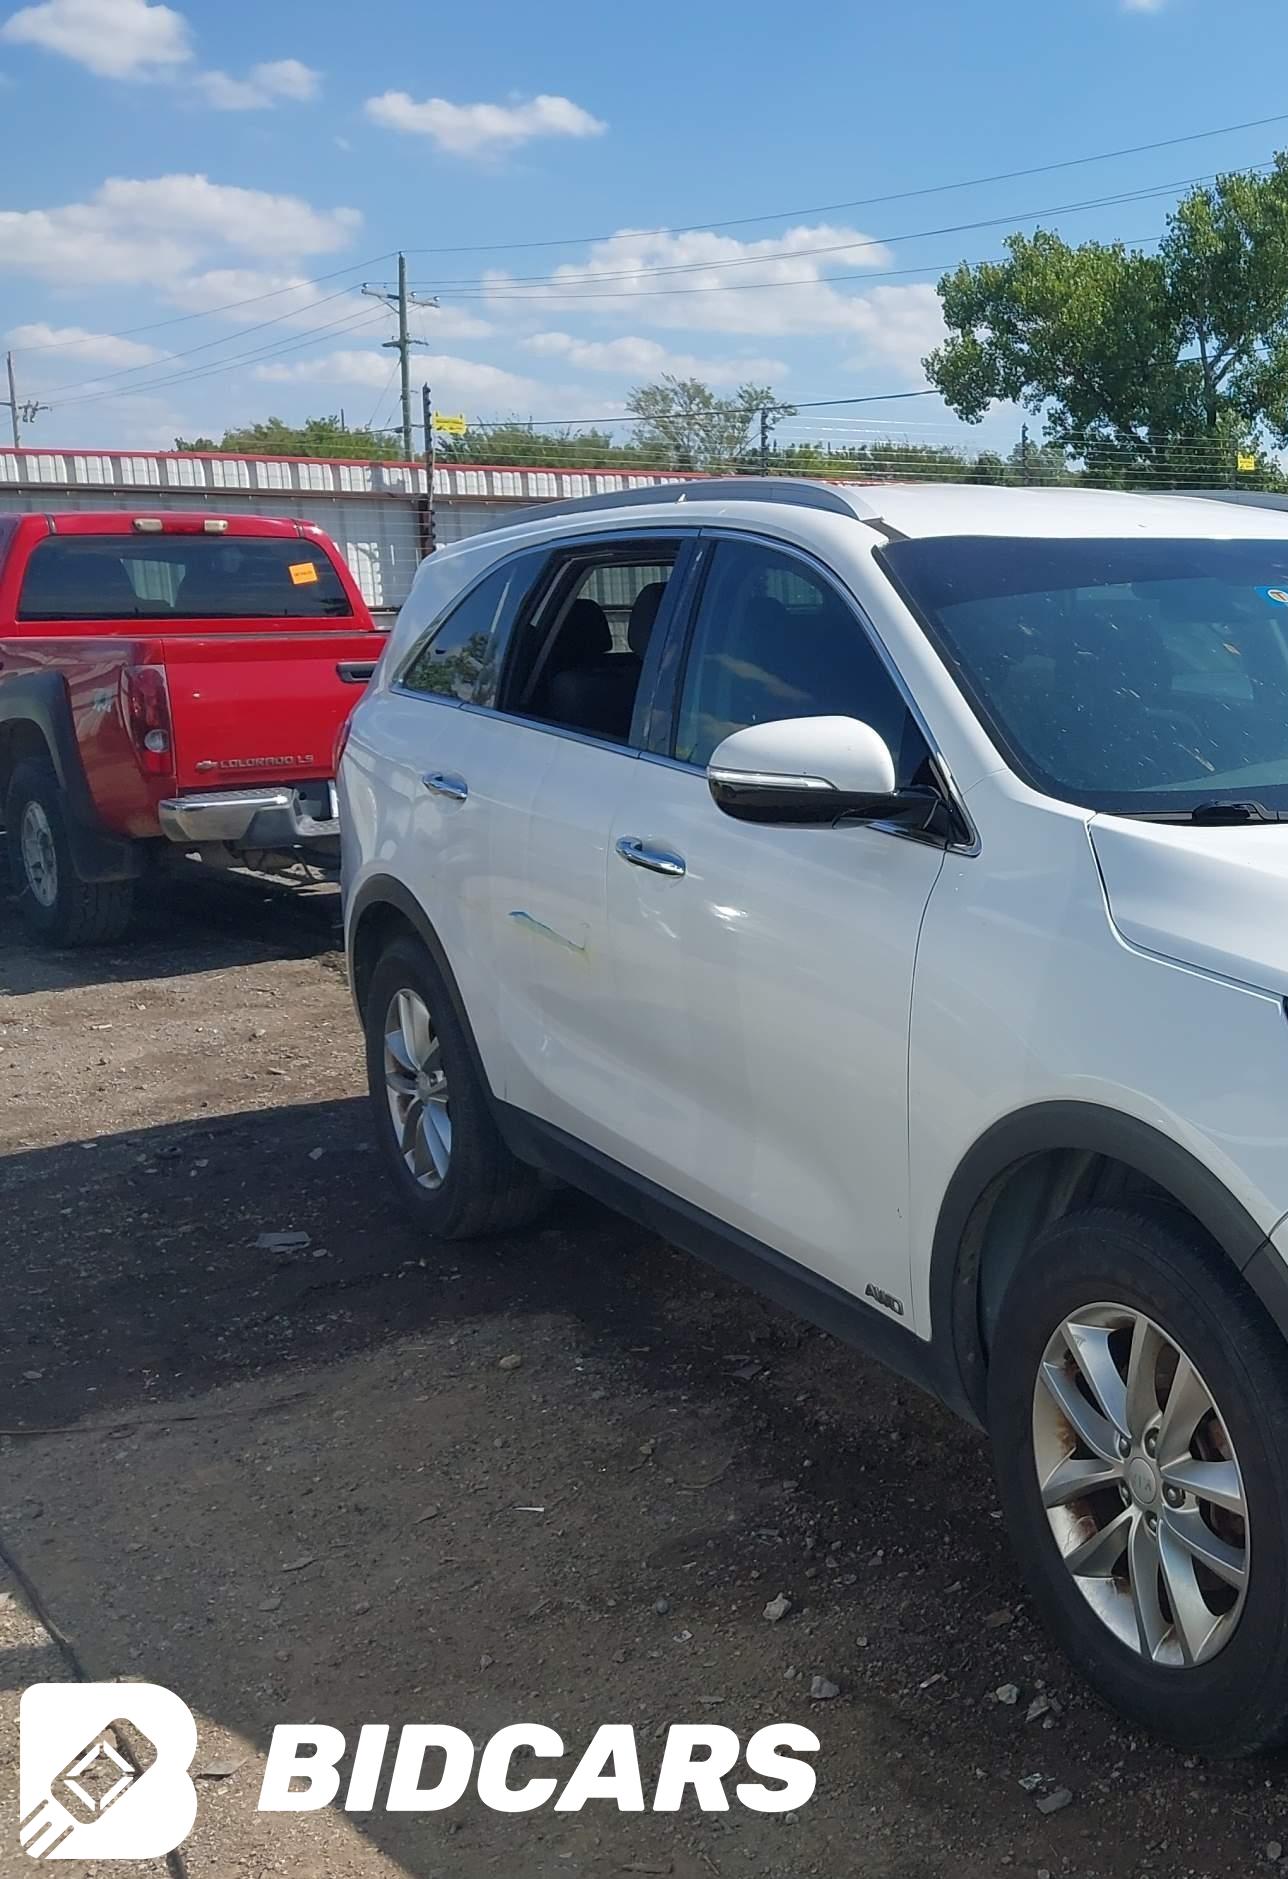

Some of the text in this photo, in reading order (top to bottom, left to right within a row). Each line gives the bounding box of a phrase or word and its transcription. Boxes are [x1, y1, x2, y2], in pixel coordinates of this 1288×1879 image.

[220, 753, 314, 769] COLORADO LS
[865, 1283, 904, 1316] AWD
